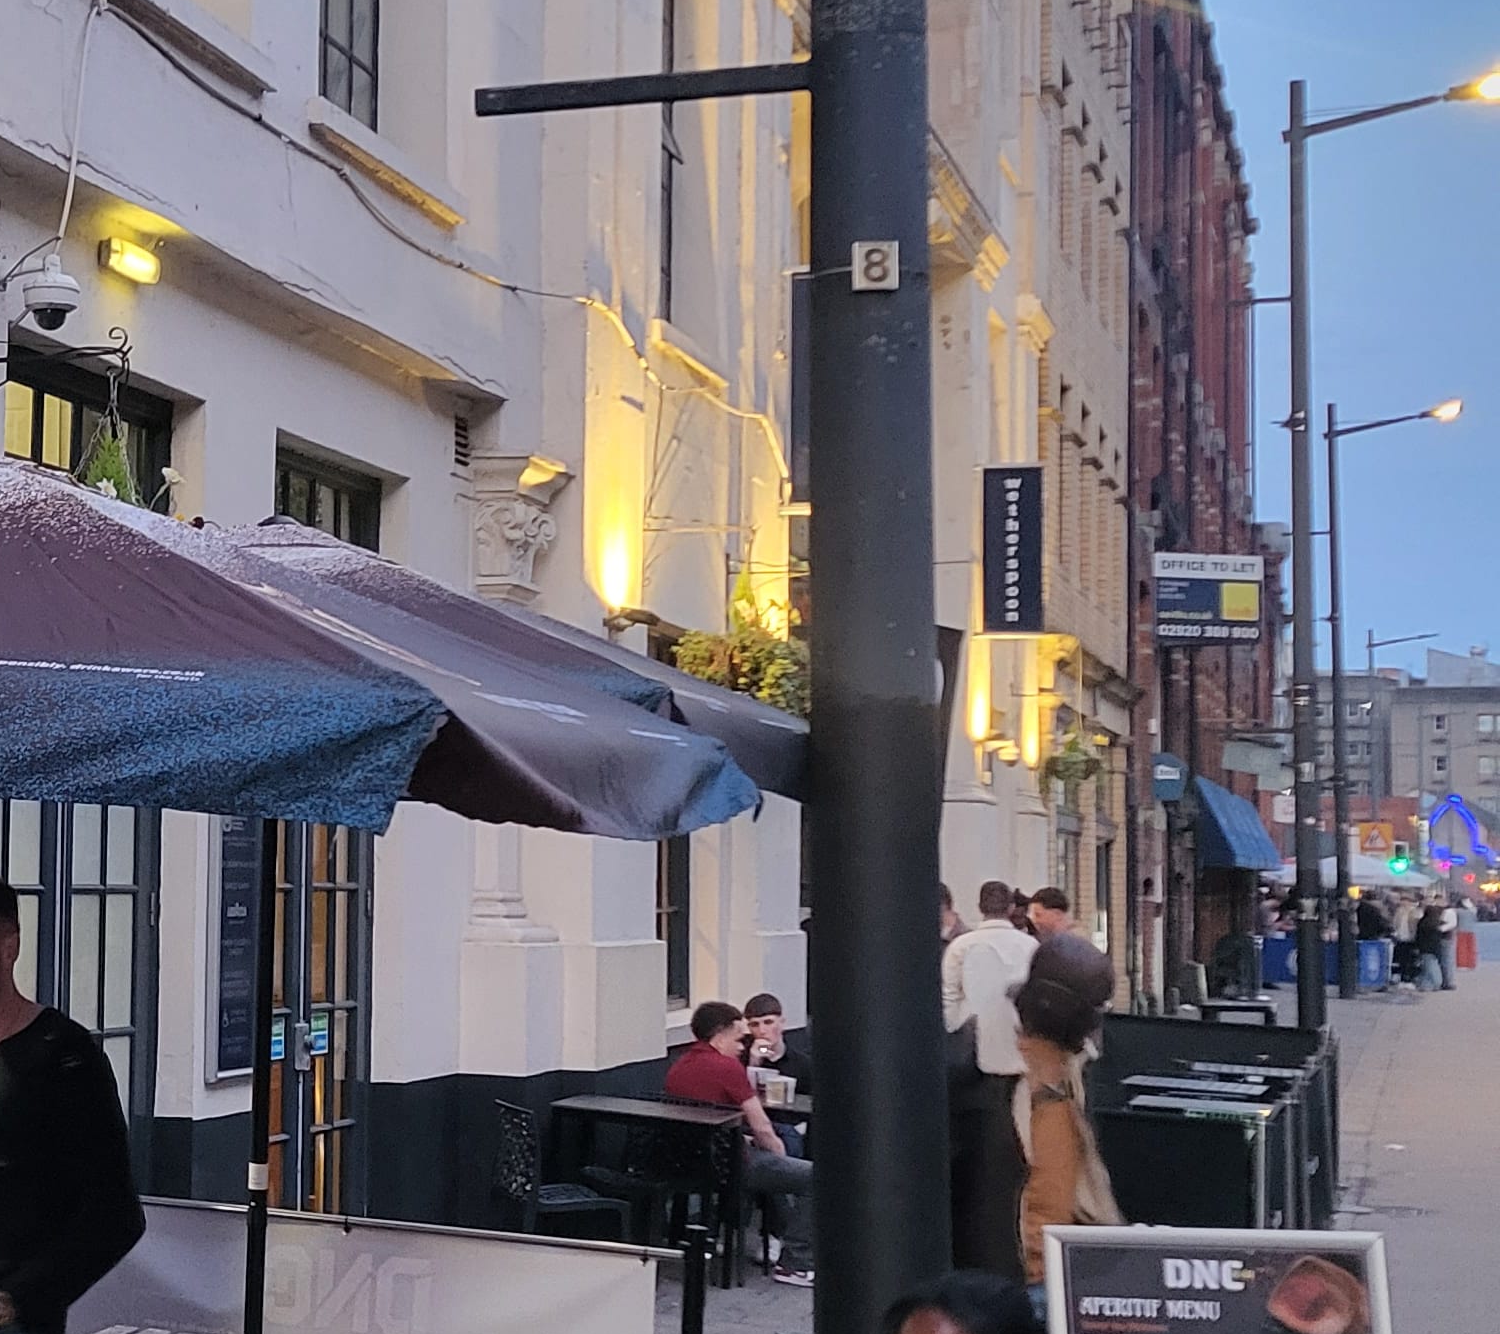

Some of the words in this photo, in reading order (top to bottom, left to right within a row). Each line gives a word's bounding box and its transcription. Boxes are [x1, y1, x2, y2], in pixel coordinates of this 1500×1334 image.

[863, 248, 890, 283] 8
[1160, 559, 1206, 572] OFFICE
[1232, 562, 1257, 573] LET
[1161, 1257, 1247, 1292] DNC
[1079, 1295, 1163, 1319] APERITIF
[1164, 1298, 1222, 1322] MENU
